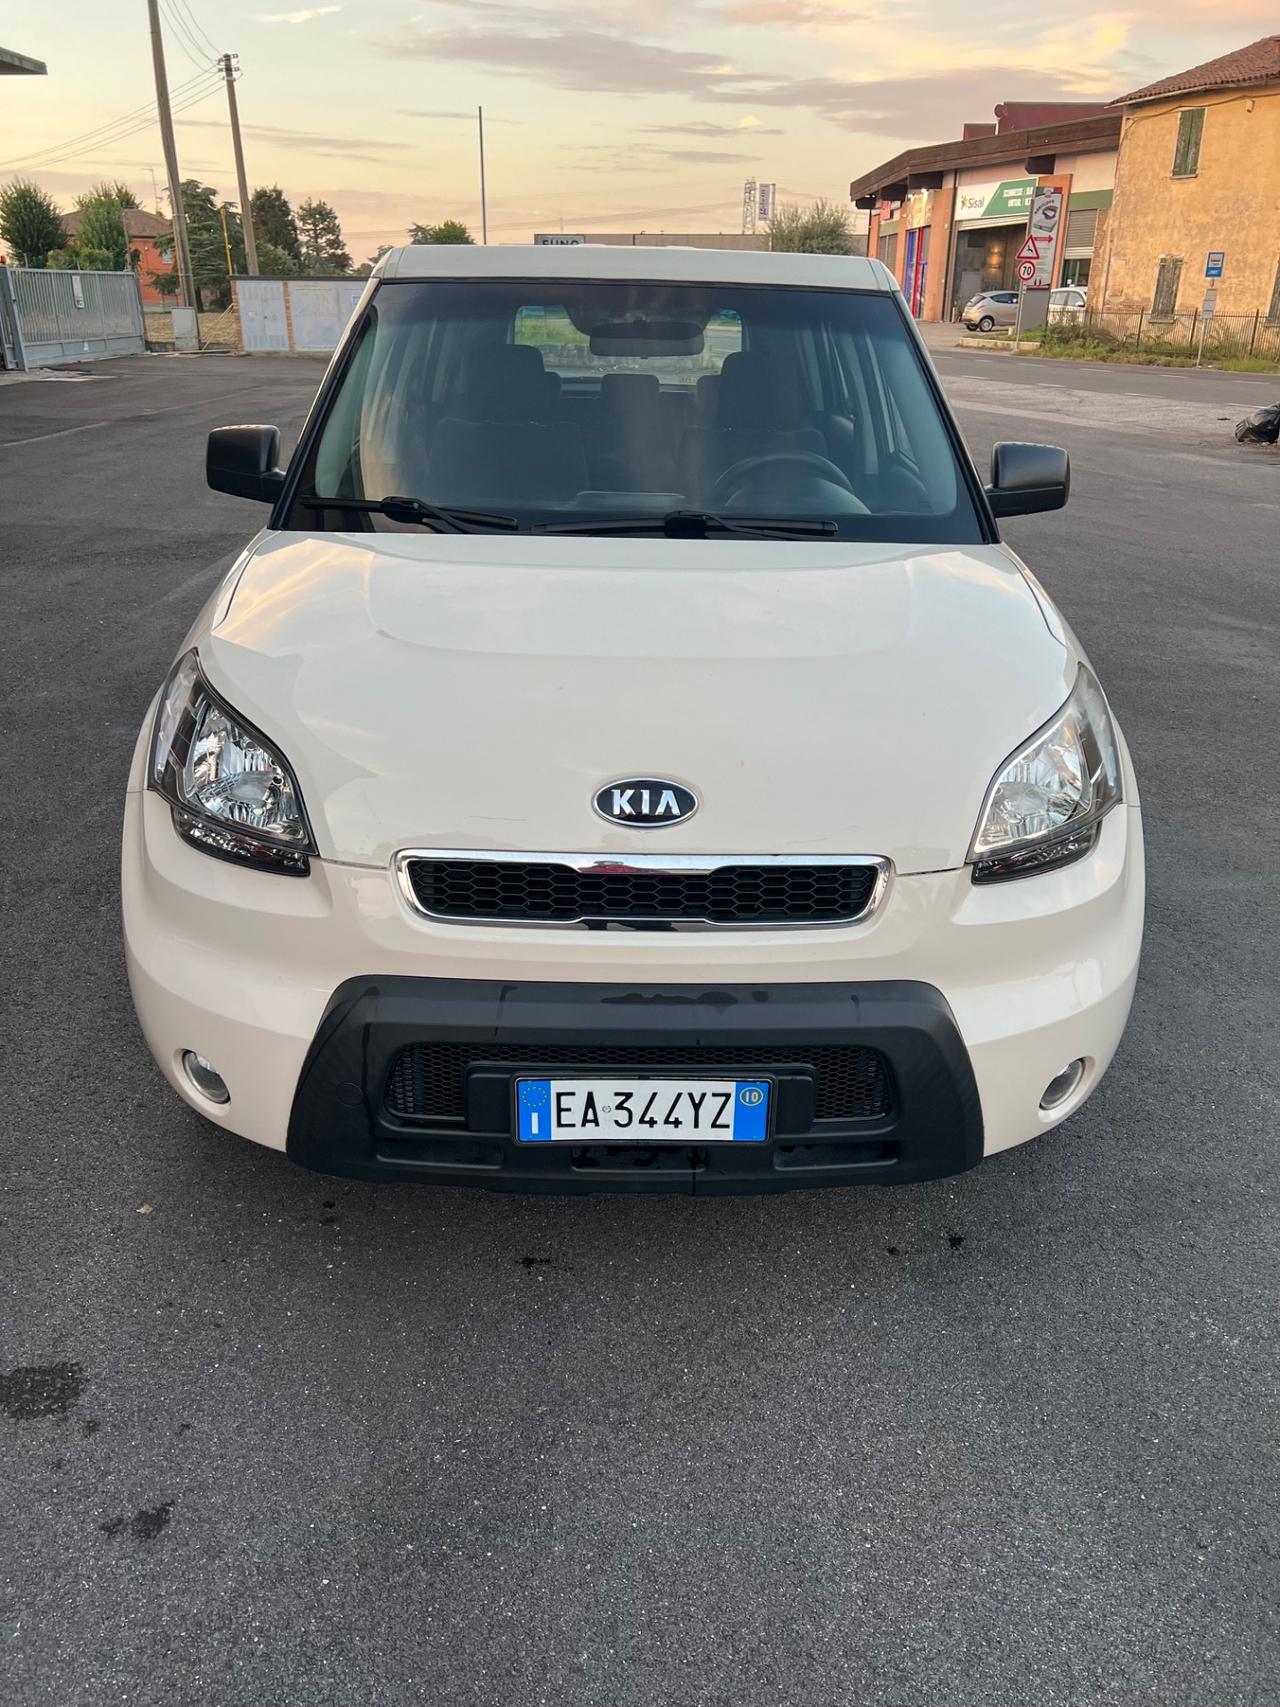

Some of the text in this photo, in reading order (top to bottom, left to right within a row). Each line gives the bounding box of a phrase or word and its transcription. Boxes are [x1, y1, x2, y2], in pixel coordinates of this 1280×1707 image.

[968, 196, 985, 209] Sisal
[1022, 265, 1032, 276] 70
[611, 789, 681, 816] KIA
[745, 1092, 759, 1103] 10
